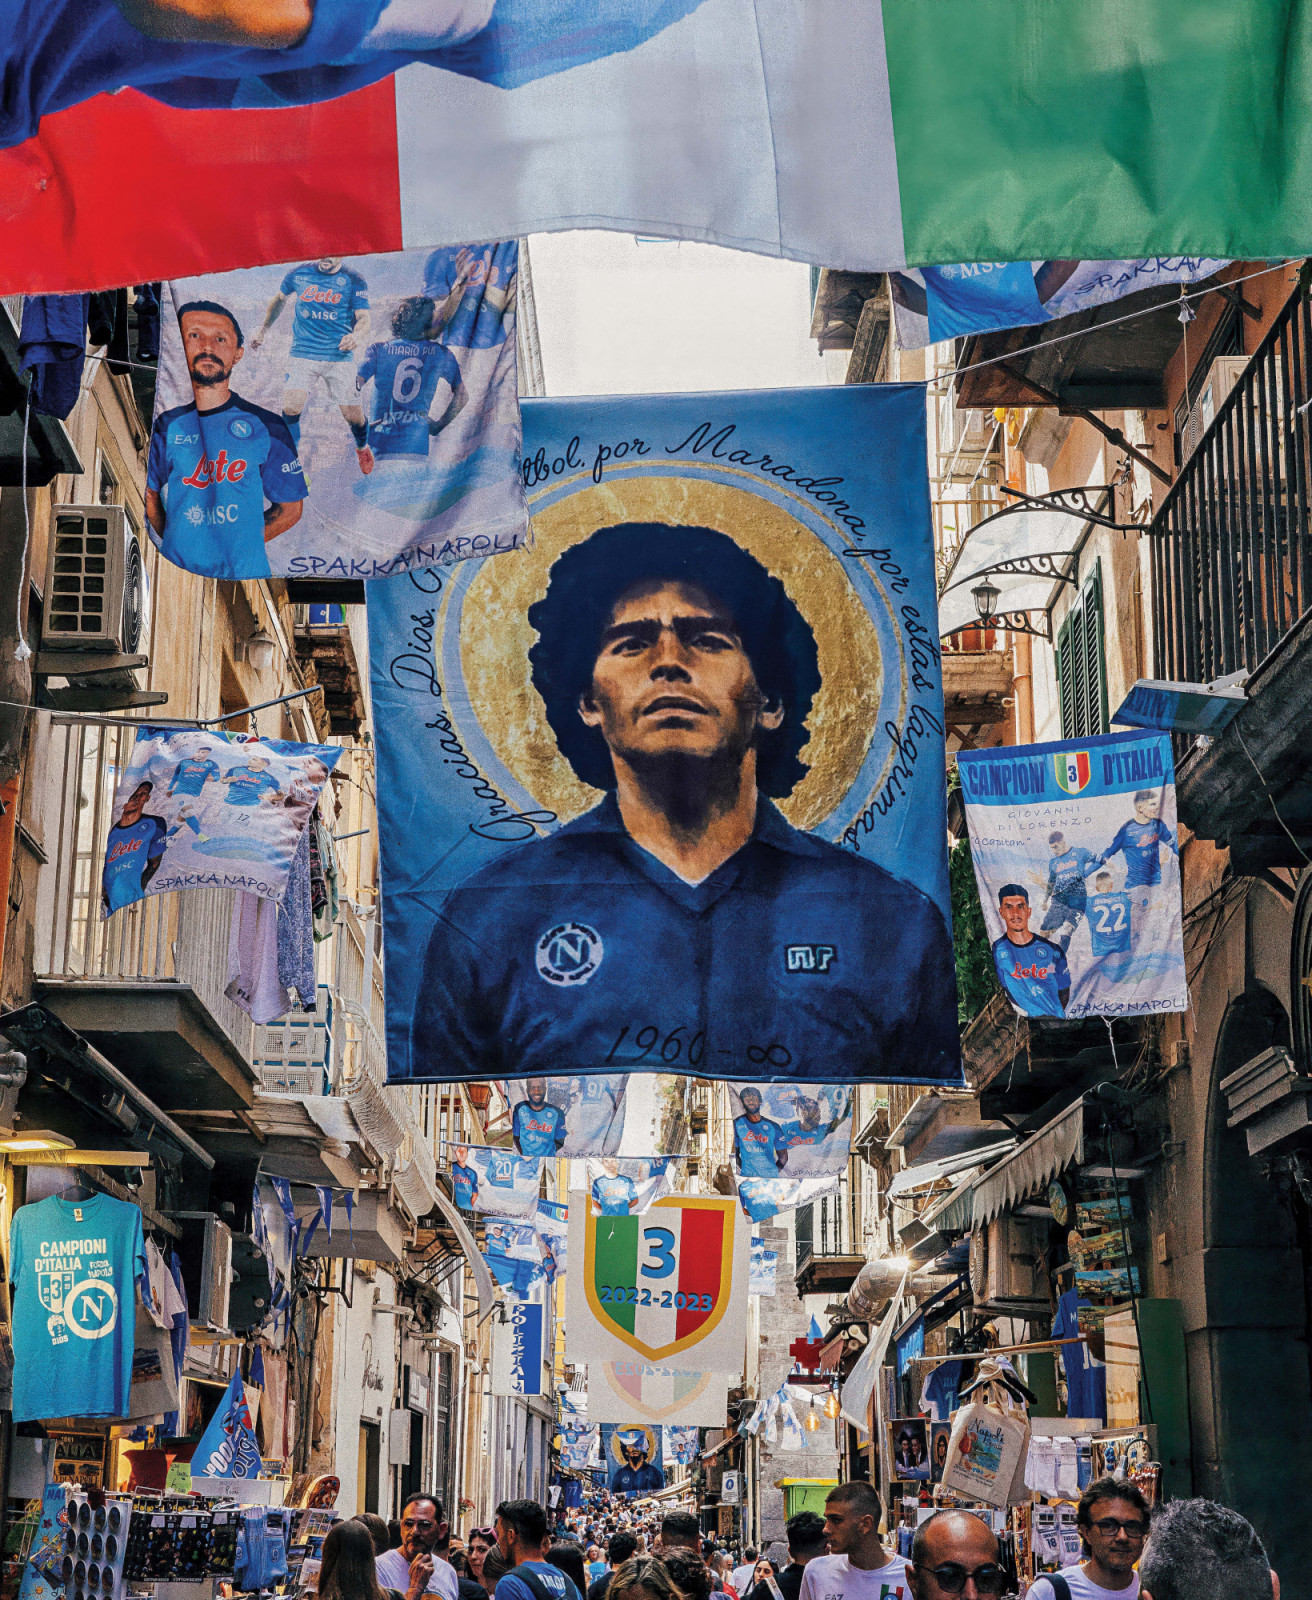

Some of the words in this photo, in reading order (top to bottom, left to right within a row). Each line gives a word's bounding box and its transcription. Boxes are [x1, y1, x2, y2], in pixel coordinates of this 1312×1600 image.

[300, 285, 342, 304] Lete
[311, 311, 339, 321] MSC
[388, 345, 420, 356] MARIO
[392, 357, 423, 403] 6
[174, 434, 199, 445] EA7
[182, 449, 248, 489] Lete
[206, 504, 239, 526] MSC
[592, 437, 651, 484] por
[843, 547, 911, 595] por
[901, 605, 938, 694] estas
[967, 761, 1045, 797] CAMPIONI
[1067, 765, 1078, 783] 3
[1102, 746, 1164, 786] D'ITALIA
[1008, 806, 1082, 819] GIOVANNI
[1019, 817, 1093, 831] LORENZO
[107, 838, 142, 863] Lete
[1093, 903, 1127, 933] 22
[1009, 961, 1049, 980] Lete
[604, 1025, 706, 1066] 1960
[525, 1118, 553, 1134] Lete
[743, 1129, 769, 1143] Lete
[495, 1160, 513, 1176] 20
[40, 1238, 107, 1257] CAMPIONI
[640, 1226, 676, 1280] 3
[34, 1257, 82, 1273] D'ITALIA
[52, 1279, 62, 1300] 3
[600, 1285, 713, 1312] 2022-2023
[79, 1295, 106, 1322] N
[51, 1334, 69, 1346] DIOS
[510, 1304, 528, 1376] POLIZIA
[1046, 1537, 1058, 1549] 18
[1064, 1541, 1079, 1553] 10
